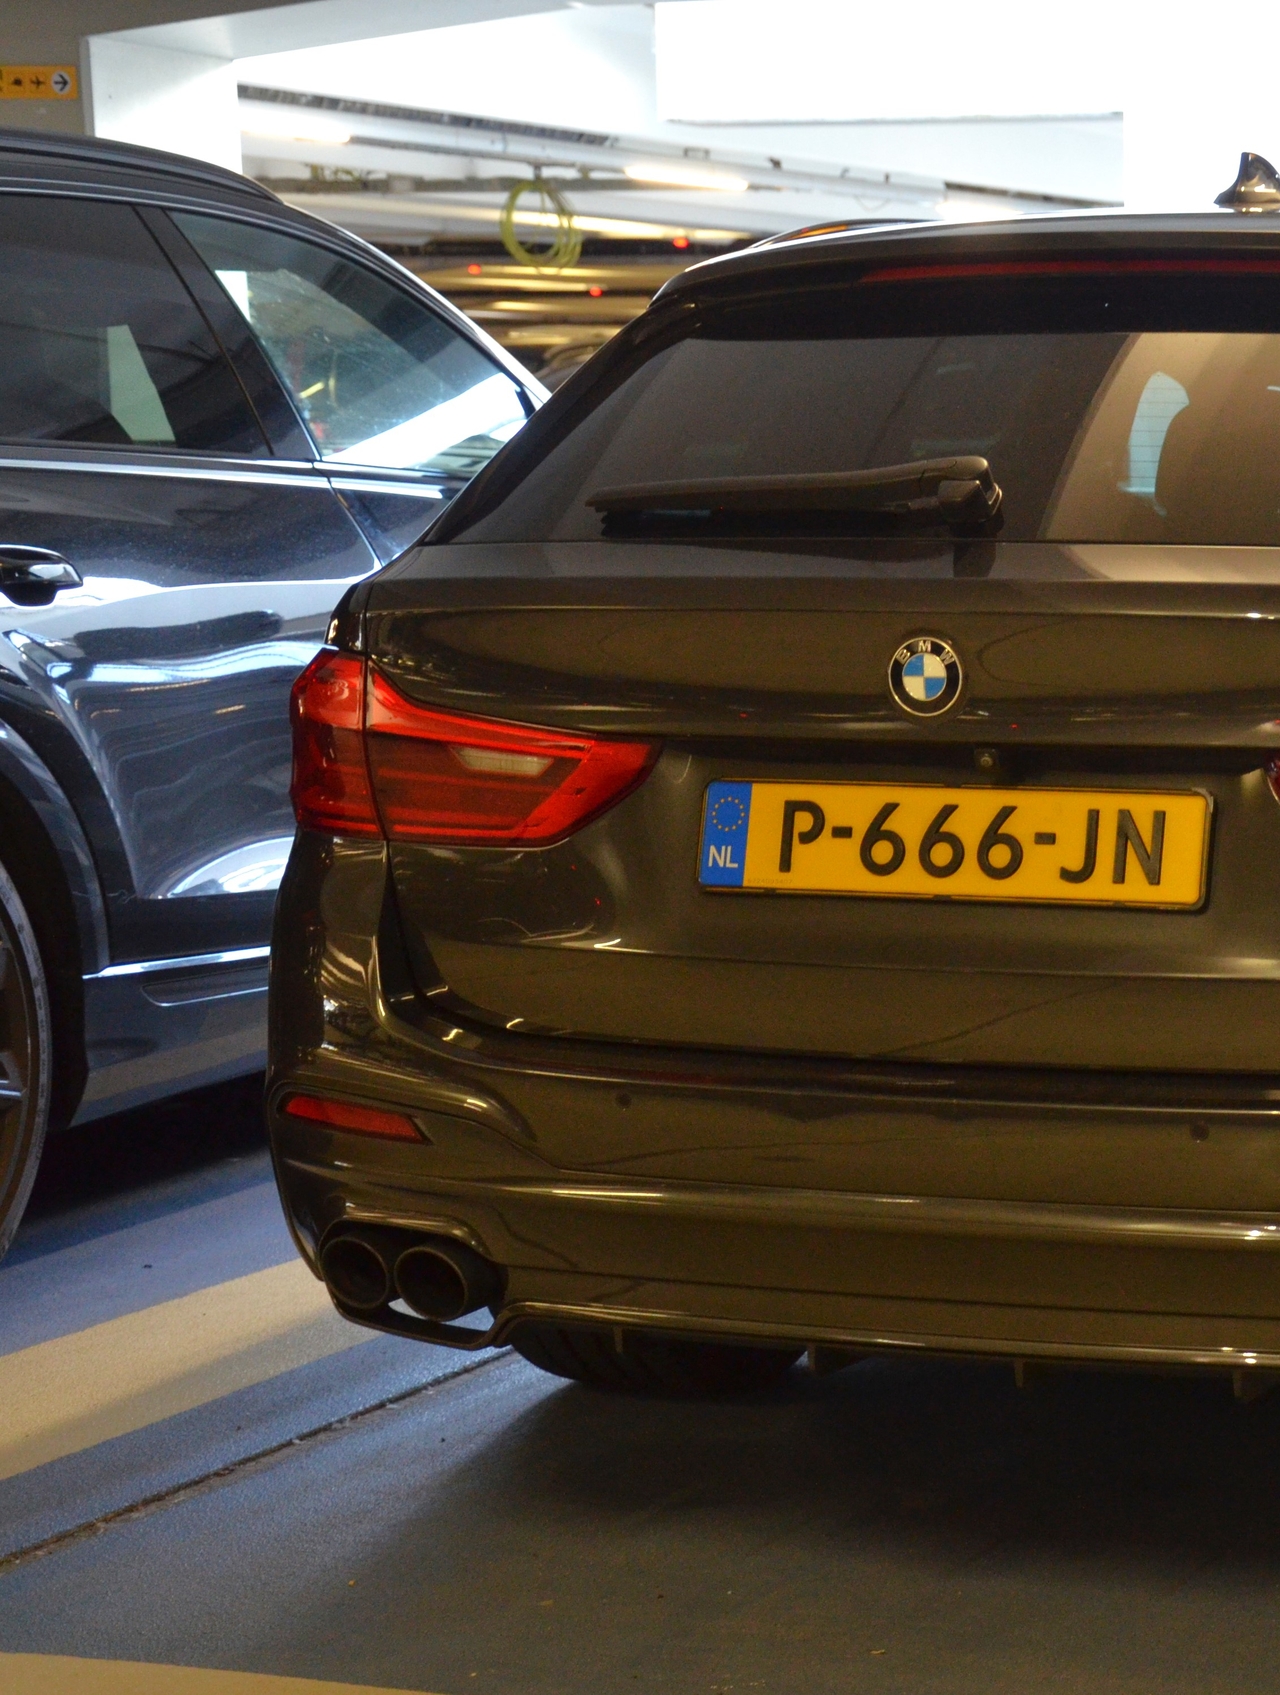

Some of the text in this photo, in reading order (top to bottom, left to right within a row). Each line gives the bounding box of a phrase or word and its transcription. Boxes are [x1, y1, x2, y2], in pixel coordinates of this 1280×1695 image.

[895, 639, 955, 666] BMW
[708, 844, 739, 868] NL
[778, 799, 1167, 886] P-666-JN
